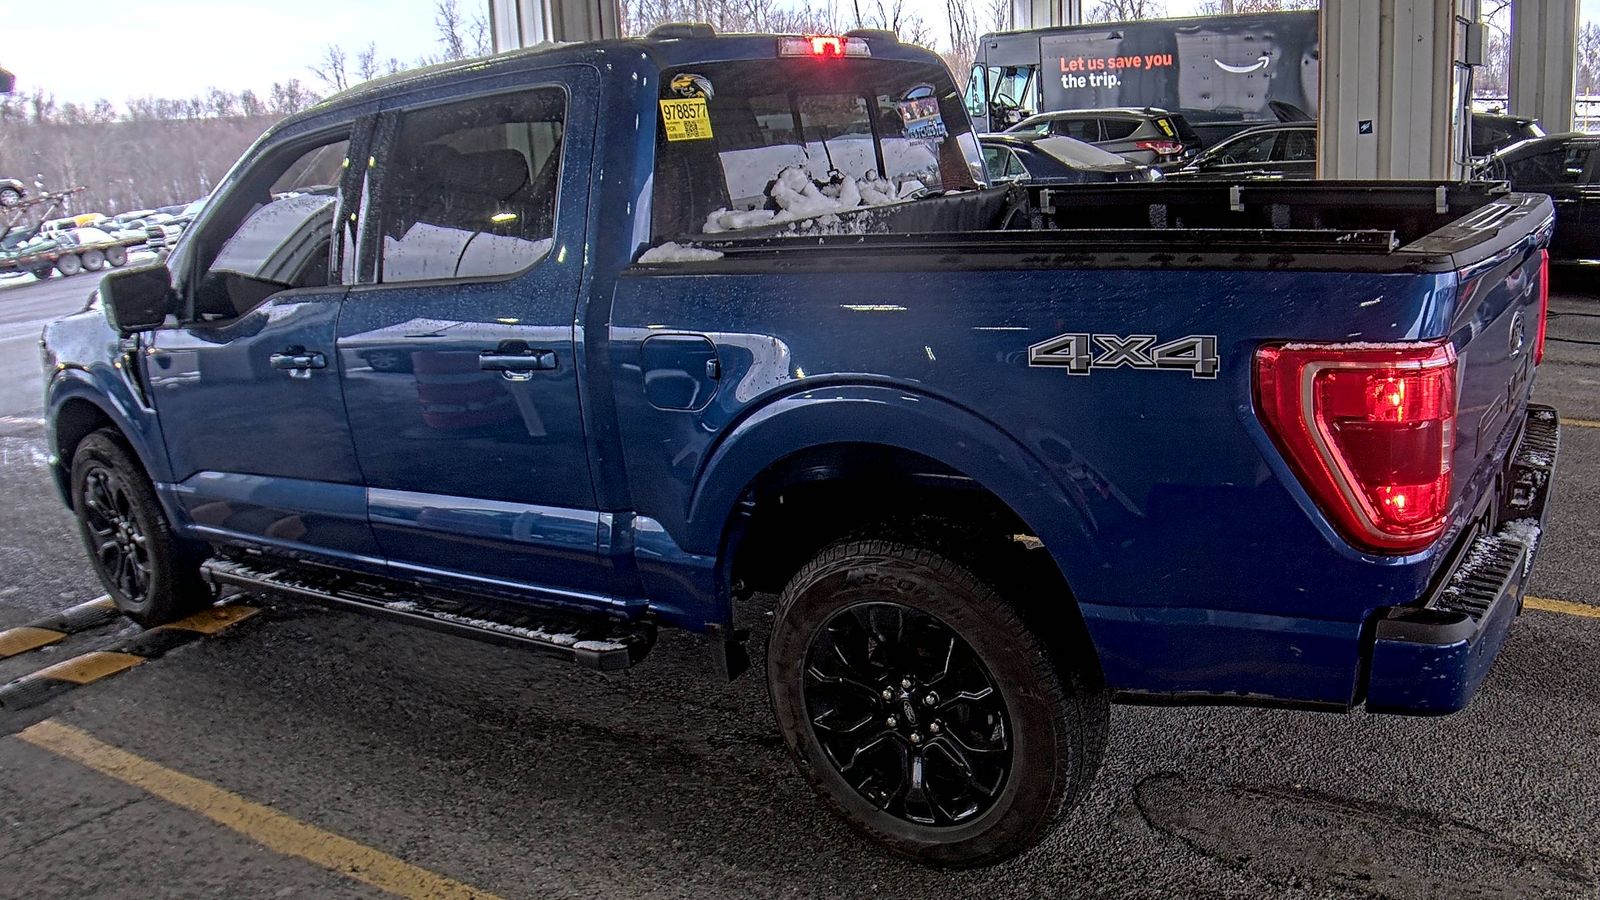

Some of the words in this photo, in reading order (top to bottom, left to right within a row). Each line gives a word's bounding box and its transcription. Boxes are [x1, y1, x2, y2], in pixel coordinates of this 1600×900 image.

[1060, 57, 1085, 71] Let
[1087, 58, 1105, 70] us
[1107, 55, 1142, 69] save
[1144, 54, 1173, 70] you
[1061, 73, 1086, 89] the
[1088, 71, 1122, 89] trip.
[663, 103, 706, 120] 9788577
[1028, 333, 1221, 380] 4X4
